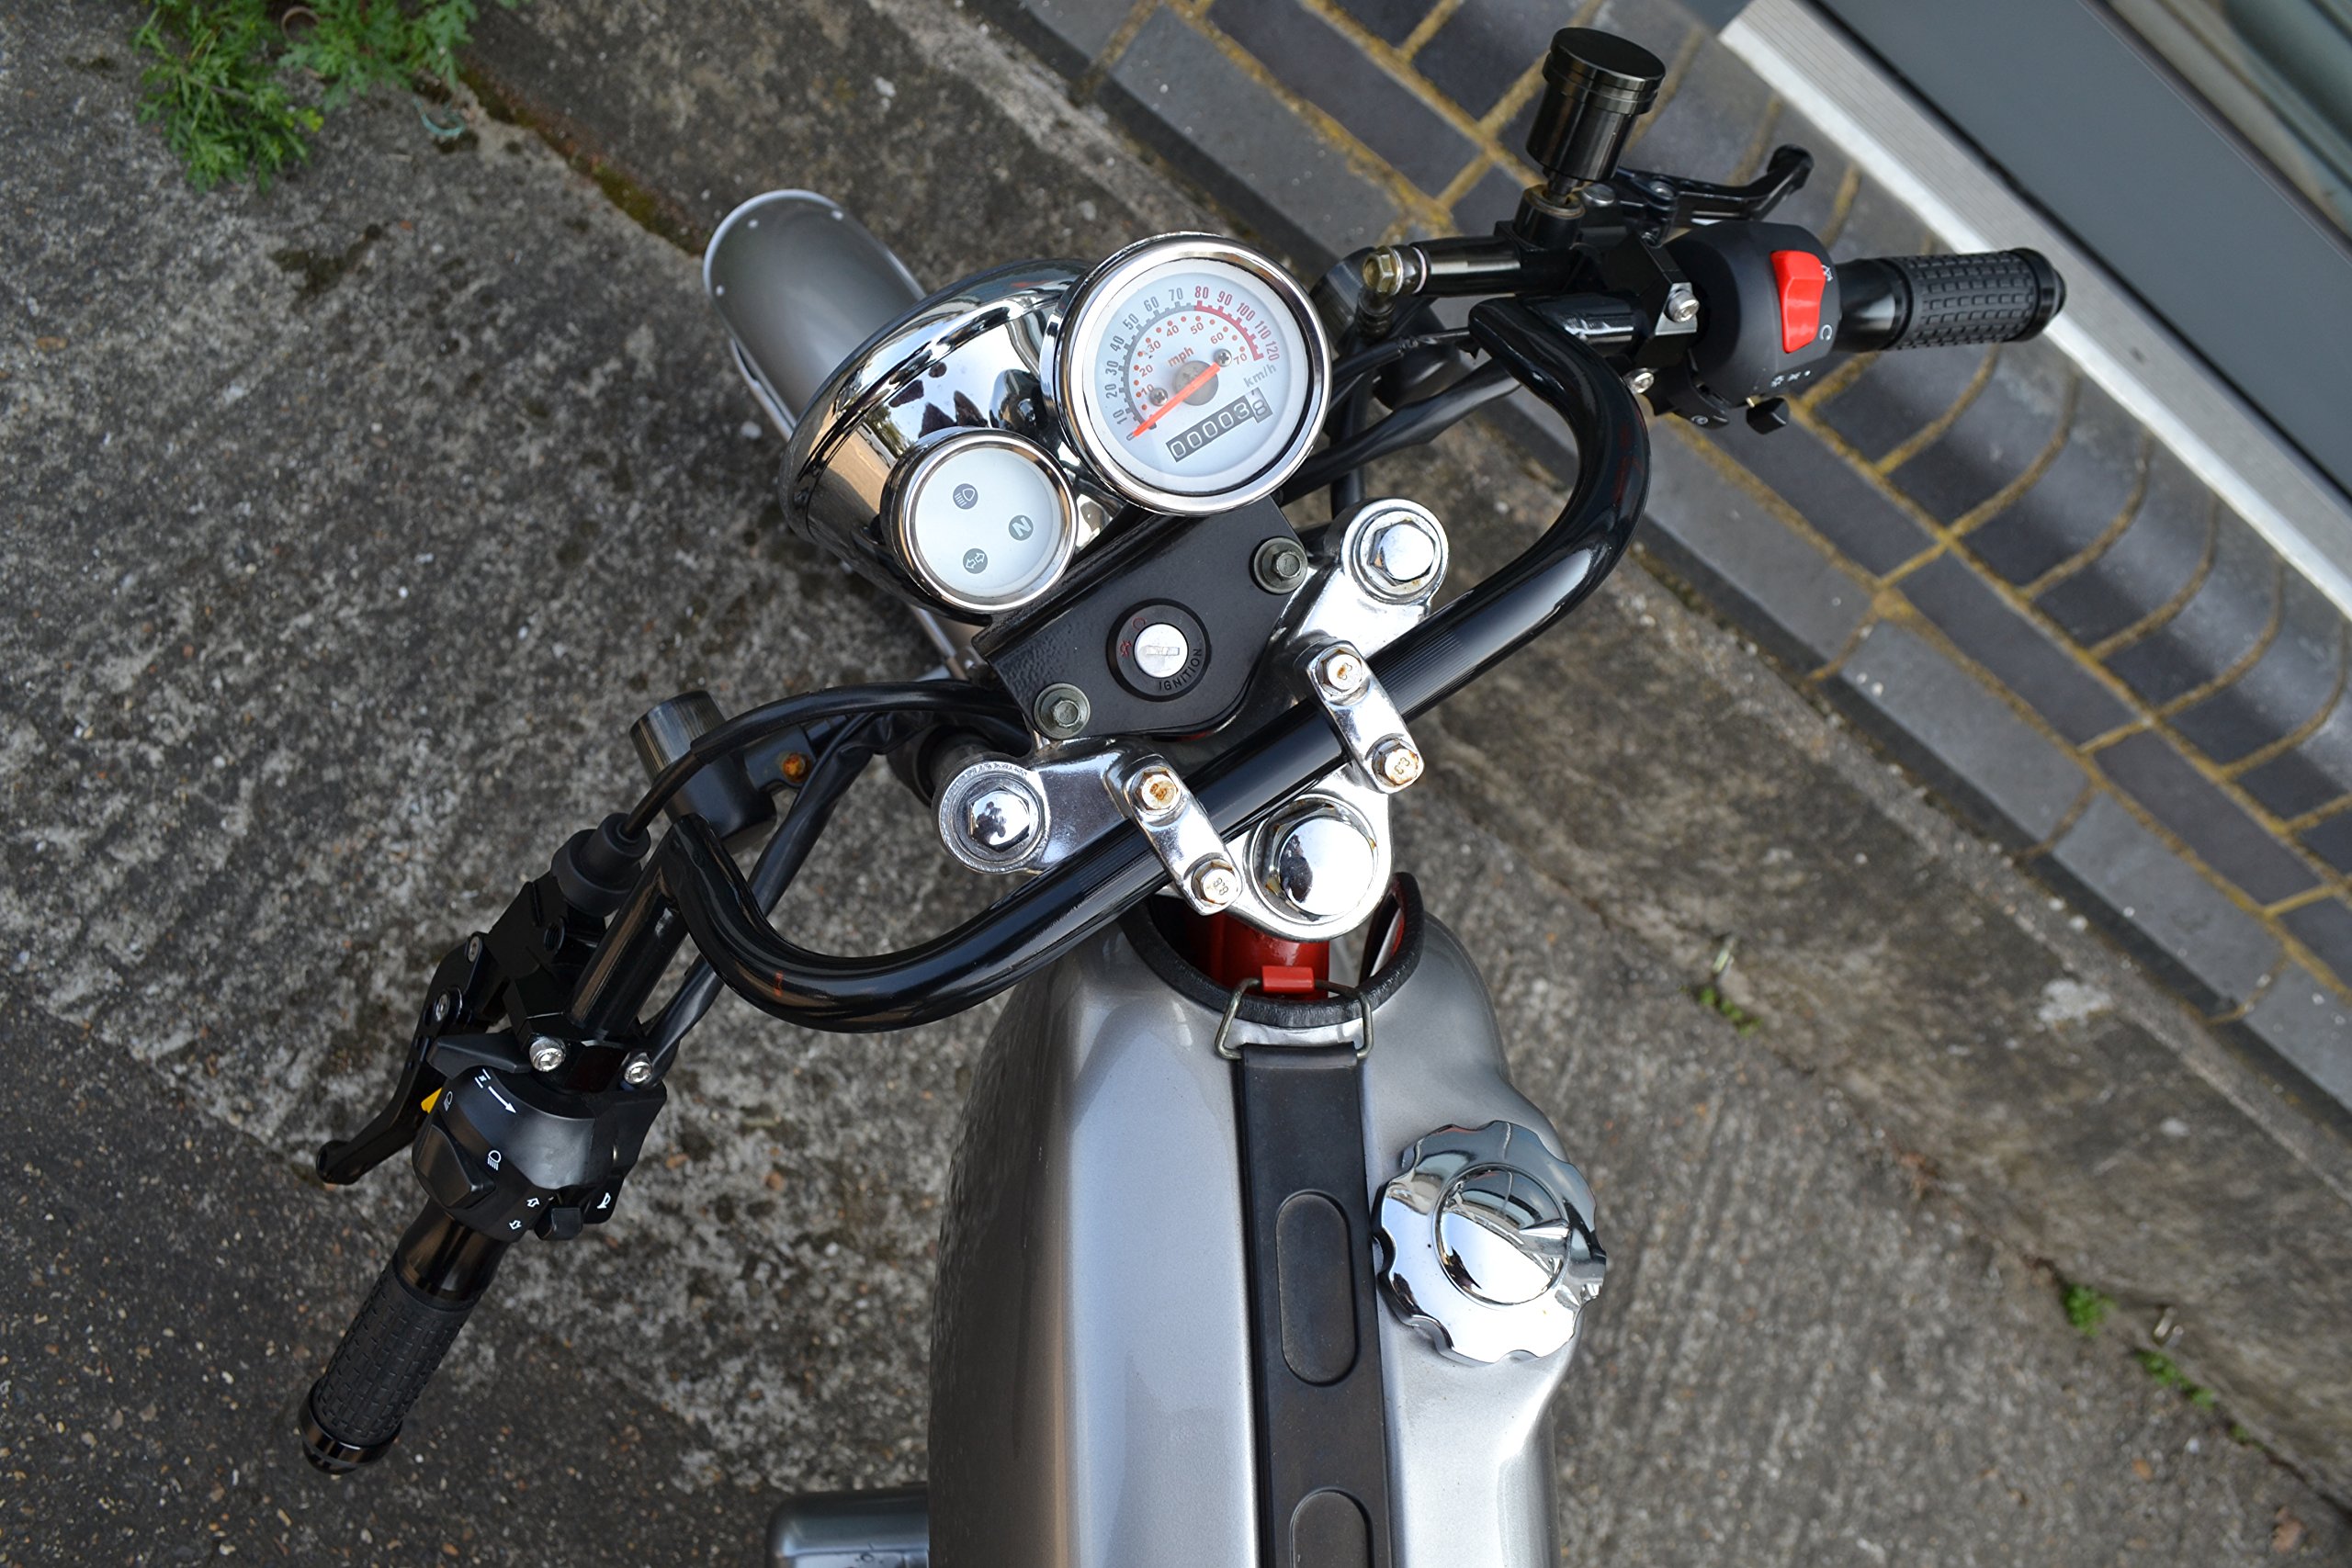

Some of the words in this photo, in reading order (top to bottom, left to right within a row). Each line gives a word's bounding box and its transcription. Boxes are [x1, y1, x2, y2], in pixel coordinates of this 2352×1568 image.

[1169, 288, 1183, 301] 70
[1194, 286, 1209, 299] 80
[1217, 290, 1233, 306] 90
[1143, 296, 1159, 312] 60
[1237, 302, 1256, 321] 100
[1123, 313, 1139, 330] 50
[1190, 322, 1204, 334] 50
[1166, 325, 1180, 337] 40
[1210, 332, 1224, 344] 60
[1254, 321, 1272, 340] 110
[1110, 335, 1125, 352] 40
[1148, 340, 1161, 353] 30
[1265, 341, 1280, 361] 120
[1168, 347, 1194, 367] mph
[1233, 353, 1248, 365] 70
[1105, 360, 1119, 376] 30
[1139, 364, 1153, 378] 20
[1243, 364, 1276, 388] km/h
[1104, 383, 1117, 399] 20
[1140, 384, 1155, 396] 10
[1113, 409, 1127, 425] 10
[1012, 516, 1032, 537] N
[1159, 649, 1203, 691] IGNITION
